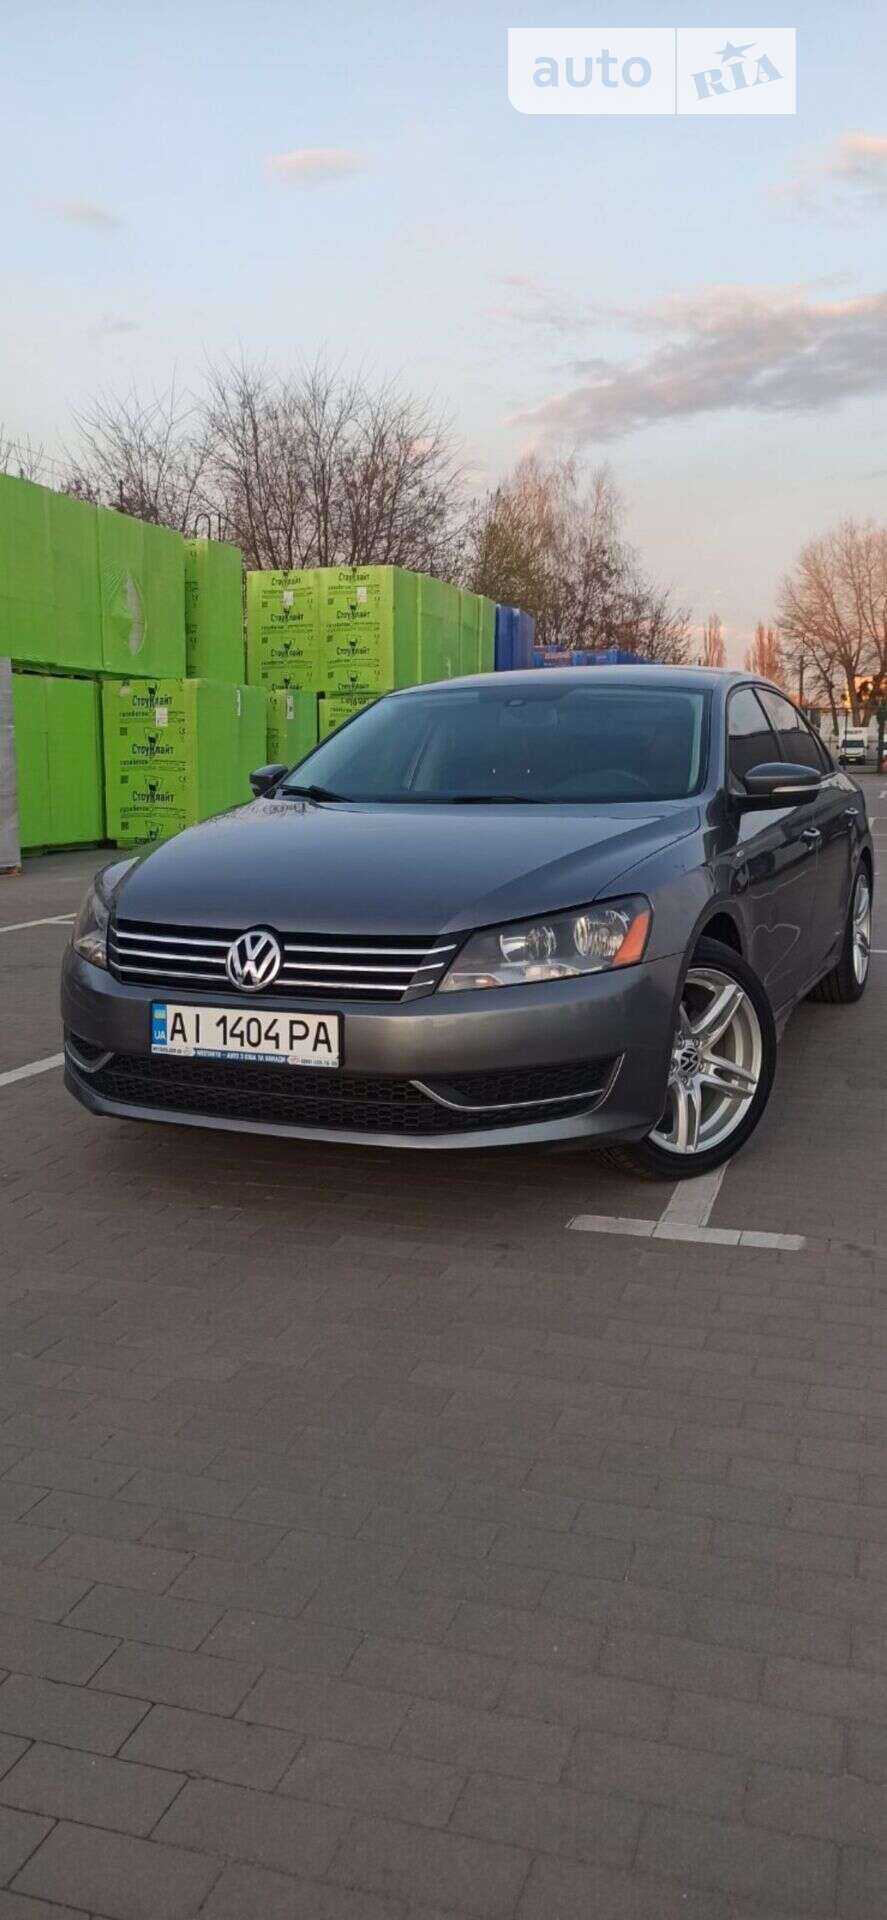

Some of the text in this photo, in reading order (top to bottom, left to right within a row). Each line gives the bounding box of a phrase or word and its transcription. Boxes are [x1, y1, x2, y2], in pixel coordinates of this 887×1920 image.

[153, 1030, 167, 1040] UA
[170, 1012, 333, 1053] AI 1404 PA
